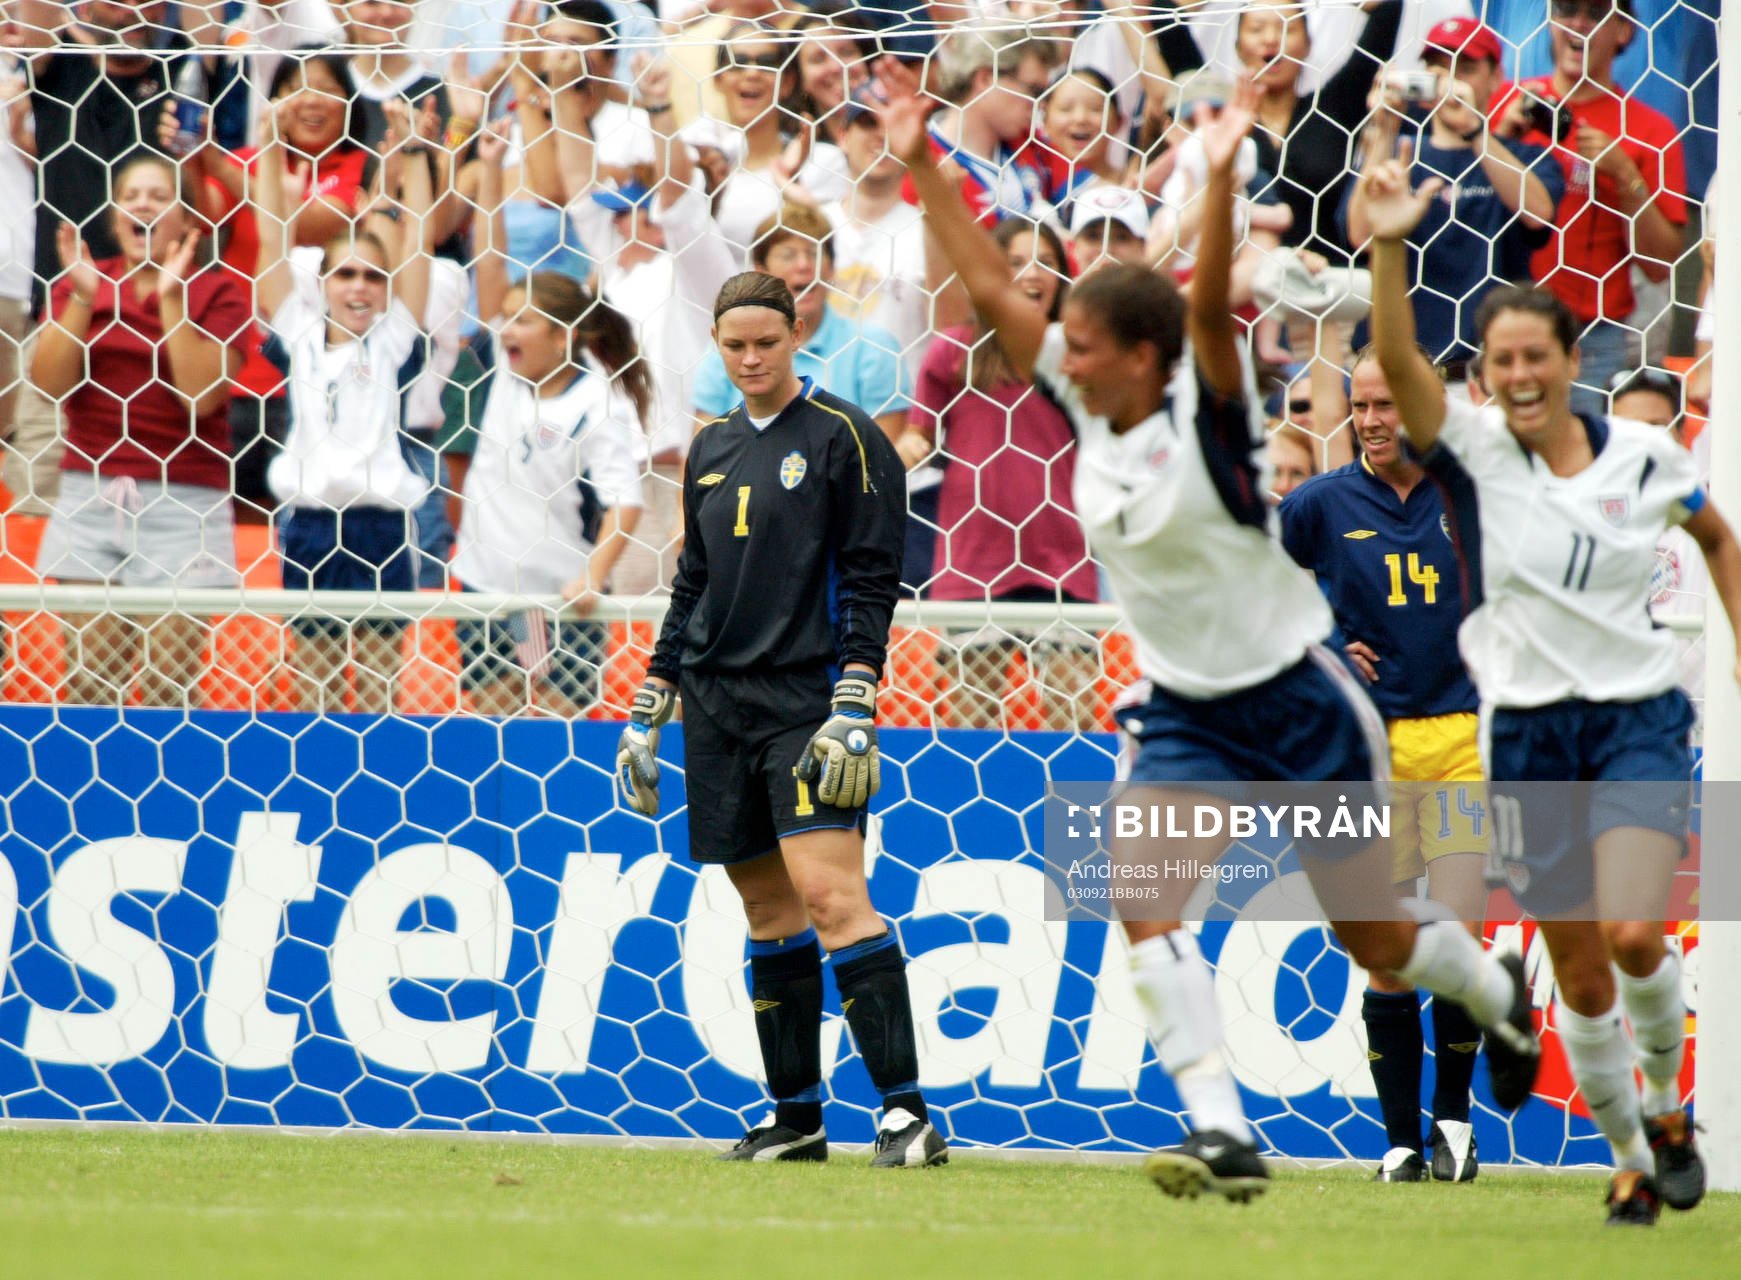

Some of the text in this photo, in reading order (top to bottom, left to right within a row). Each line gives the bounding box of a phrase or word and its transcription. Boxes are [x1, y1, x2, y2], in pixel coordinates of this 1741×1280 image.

[734, 485, 752, 537] 1
[1384, 552, 1440, 606] 14
[1562, 532, 1596, 592] 11
[792, 765, 815, 817] 1
[1435, 786, 1487, 839] 14
